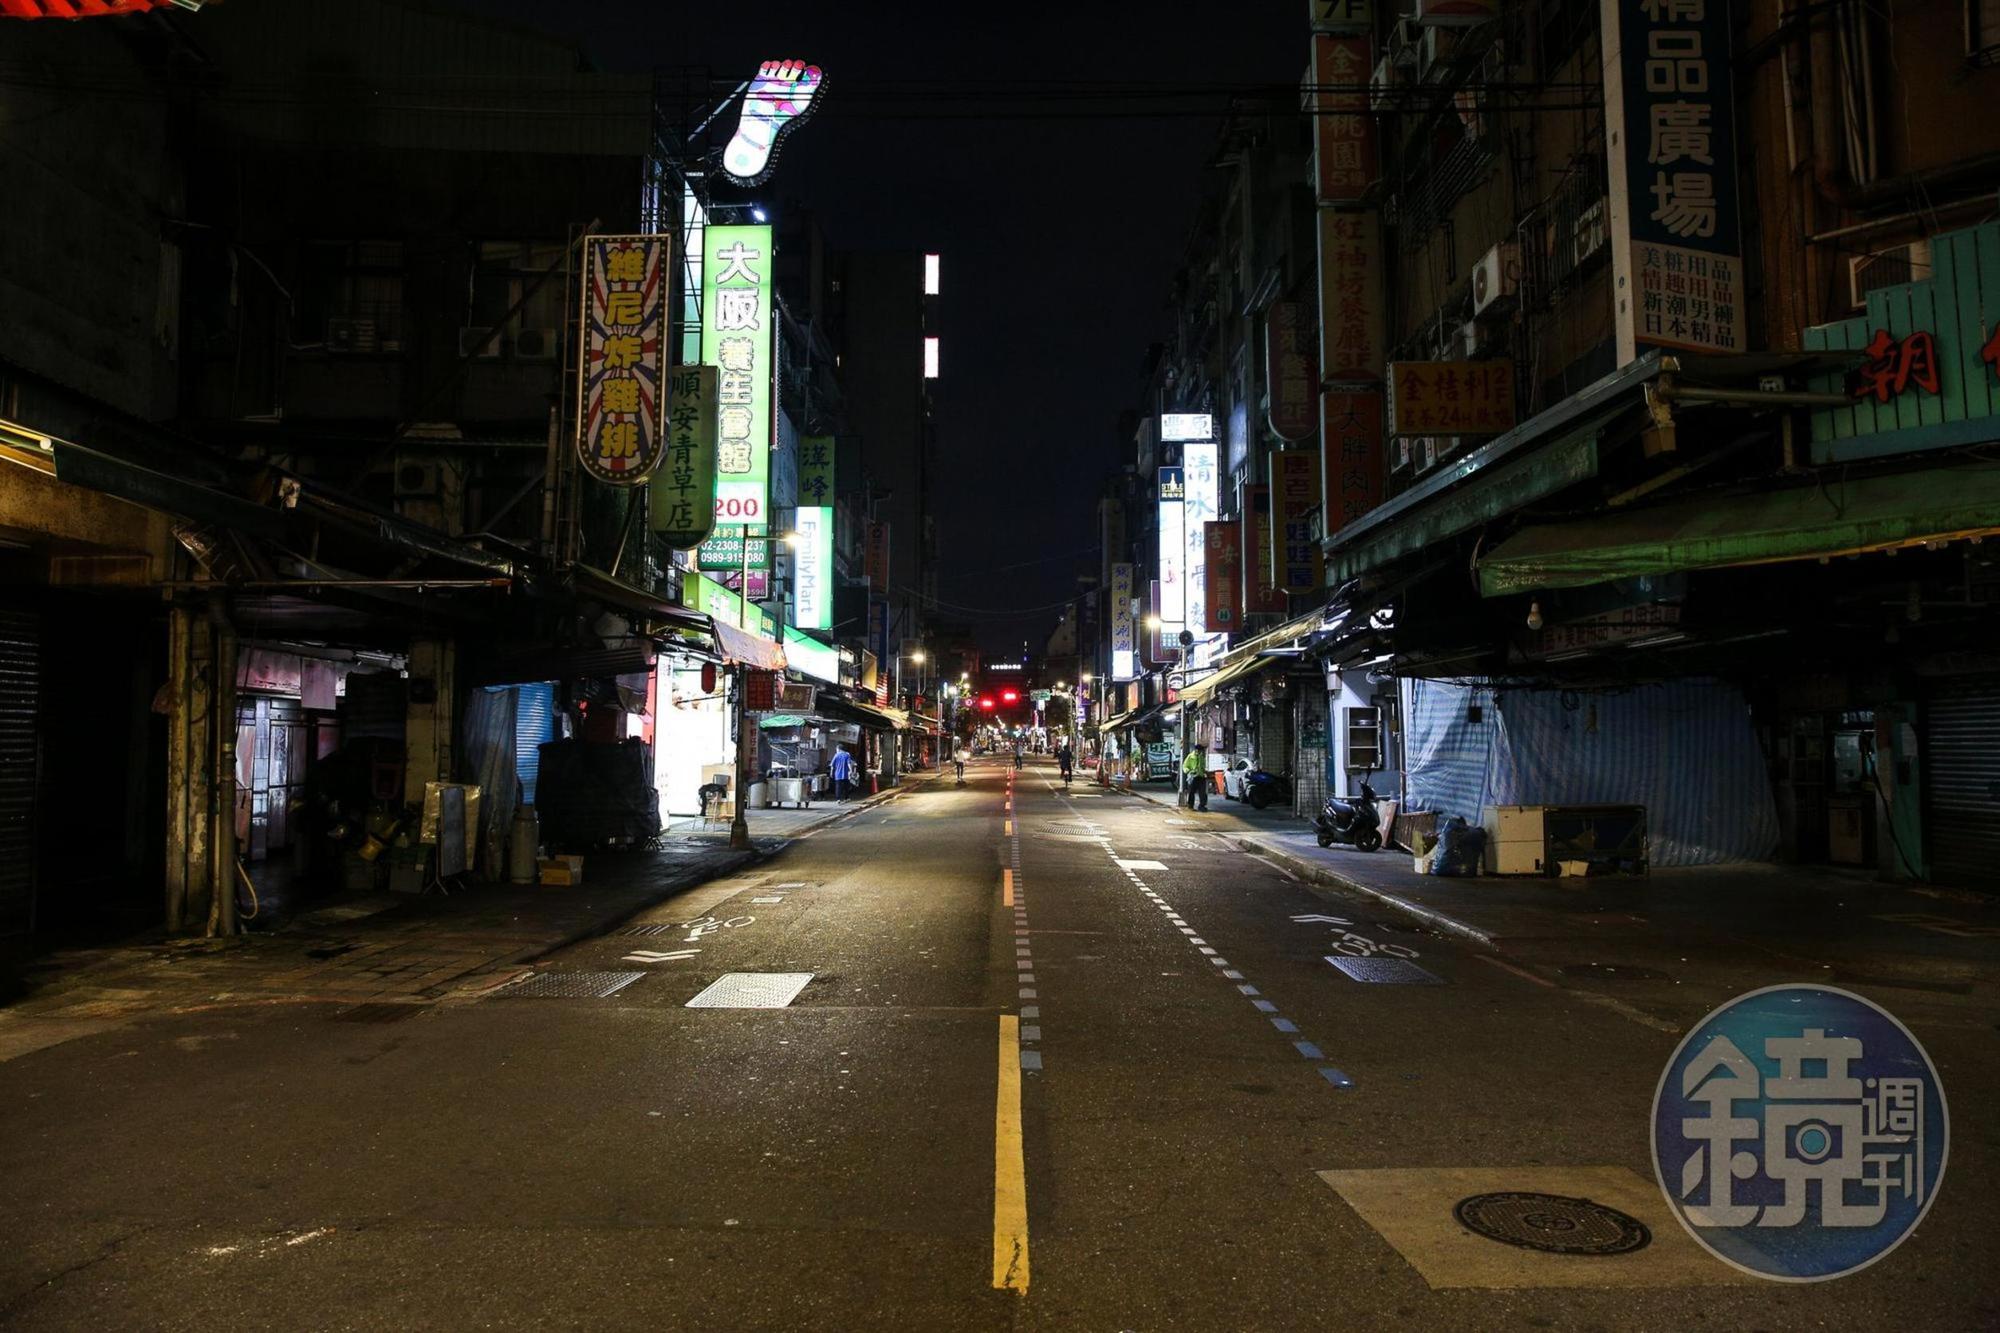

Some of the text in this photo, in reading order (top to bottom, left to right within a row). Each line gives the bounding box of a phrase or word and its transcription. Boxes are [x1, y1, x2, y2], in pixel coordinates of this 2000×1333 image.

[1641, 247, 1732, 283] 美粧用品
[1641, 269, 1733, 305] 情趣用品
[1643, 291, 1734, 326] 新潮男褲
[1645, 314, 1735, 350] 日本精品
[600, 246, 646, 459] 維尼炸雞排
[665, 371, 702, 531] 順安青草店
[801, 521, 816, 613] FamilyMart
